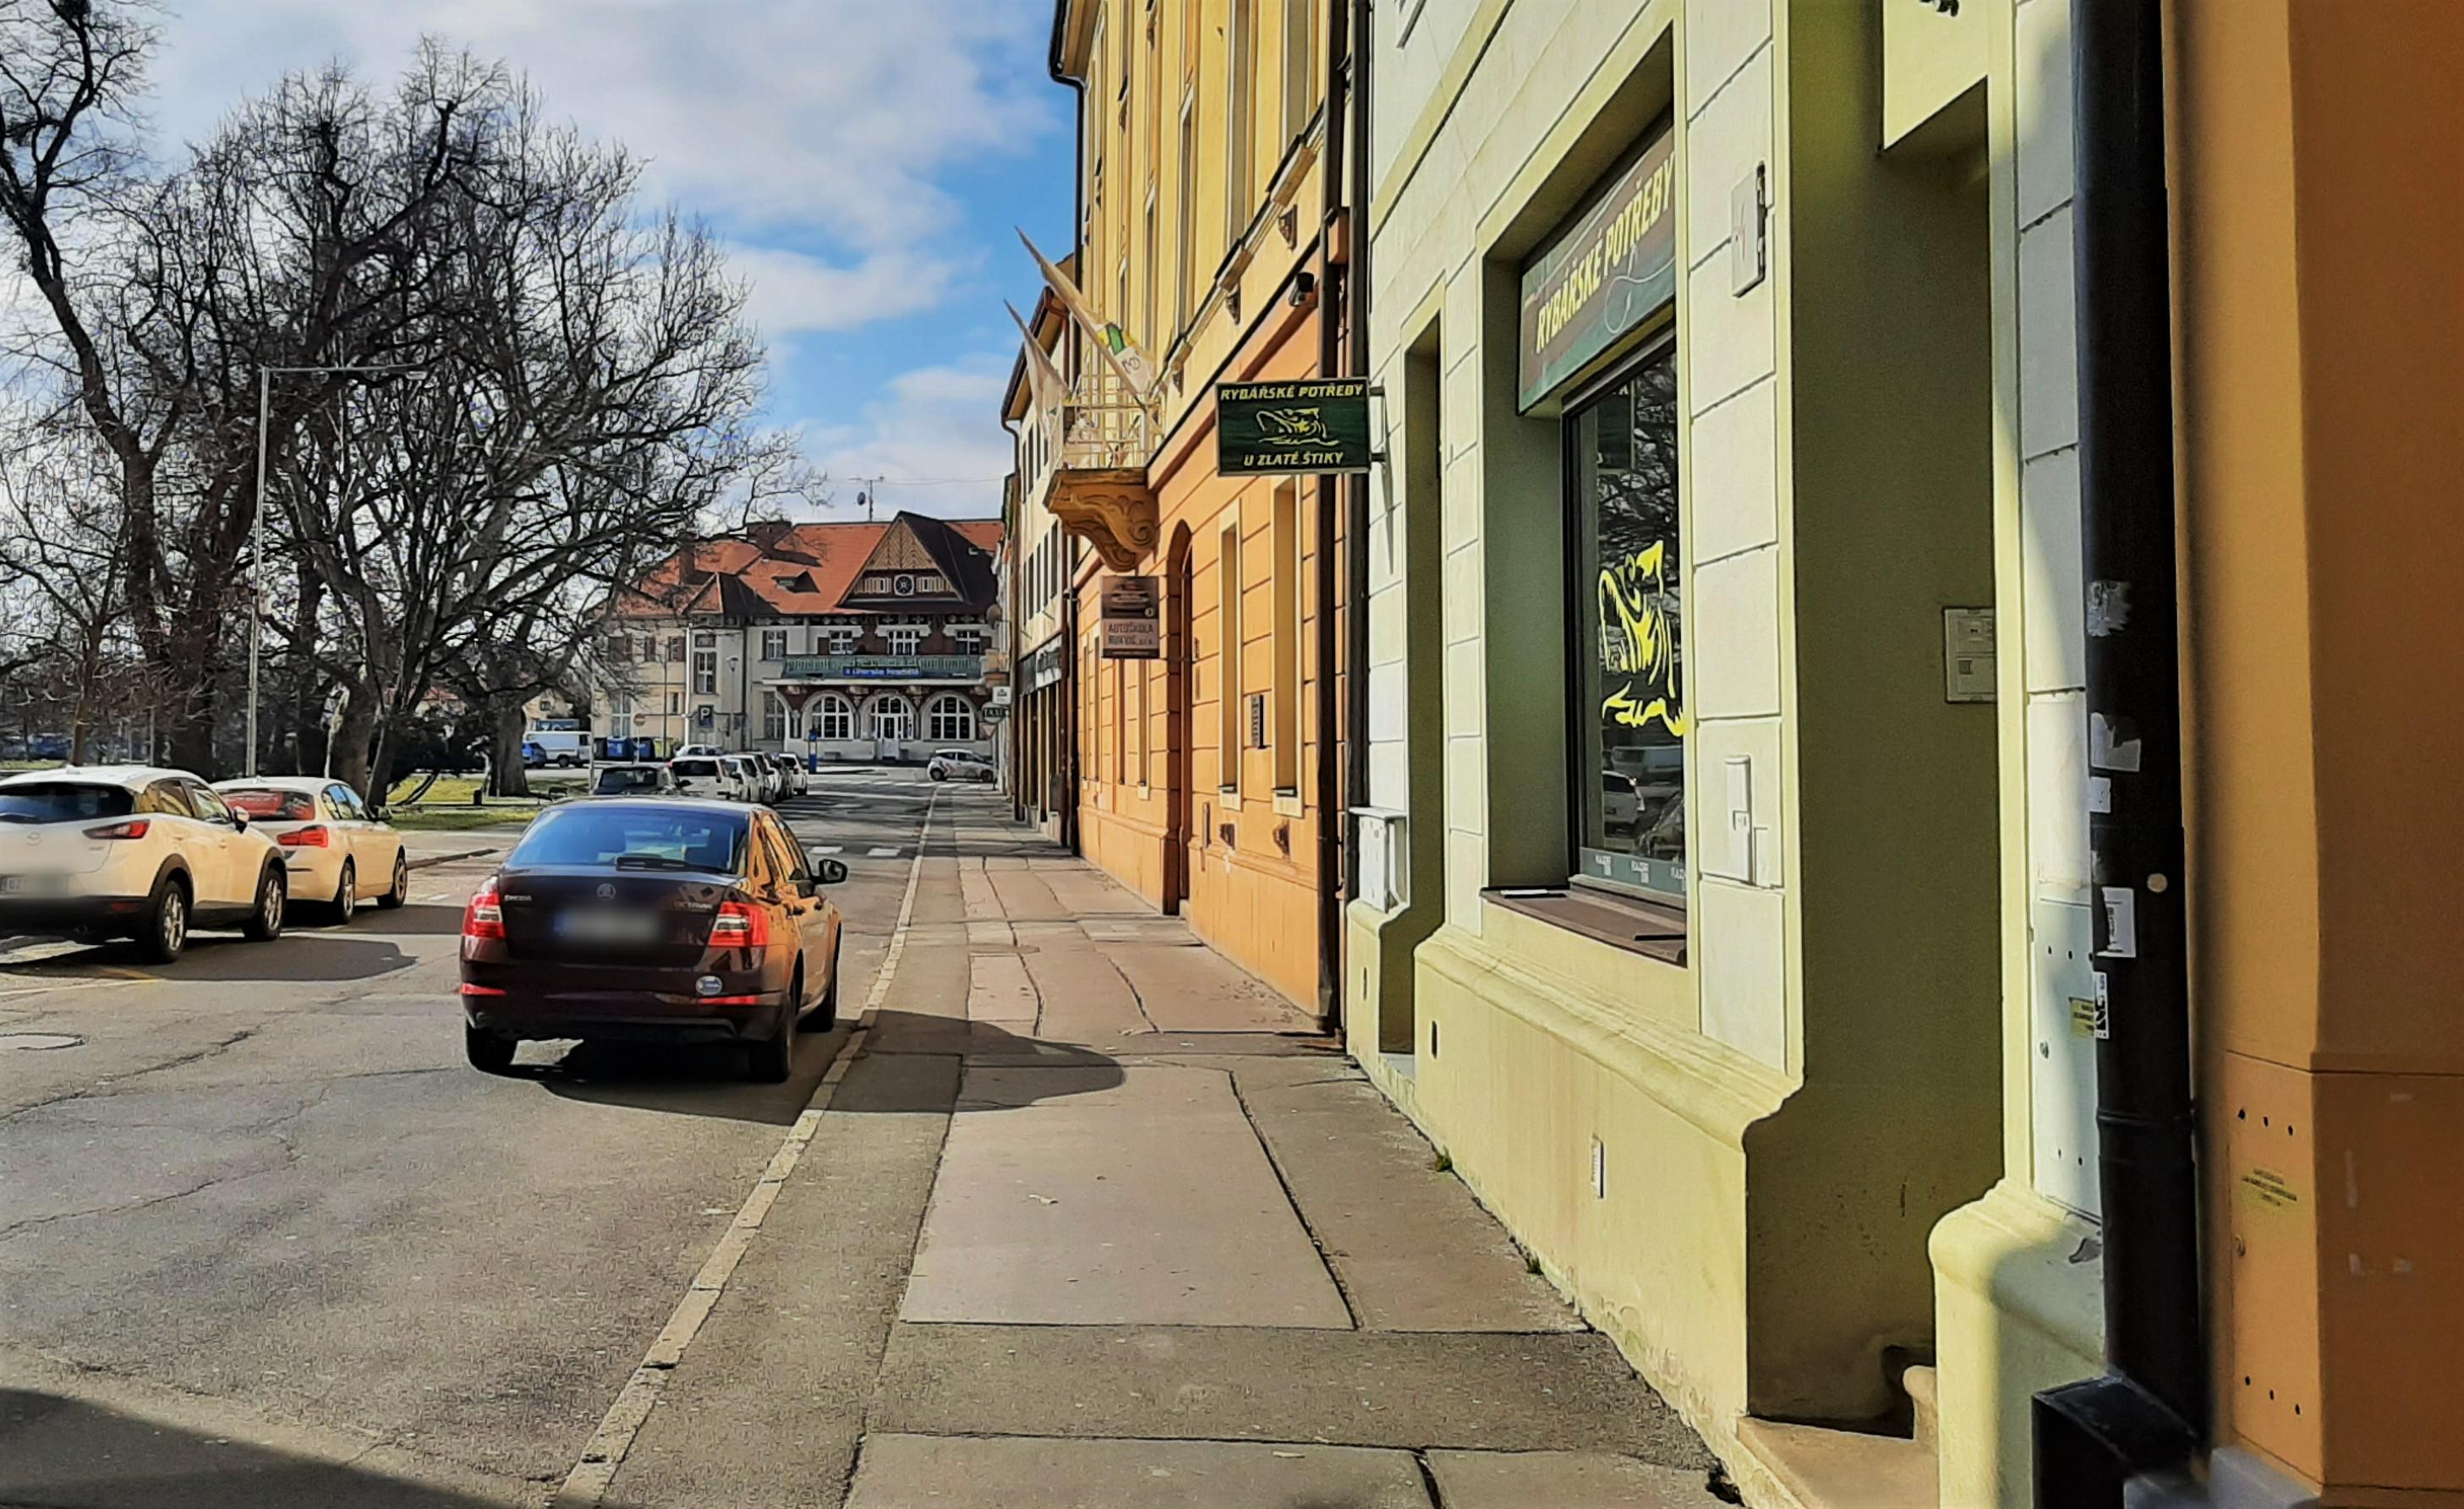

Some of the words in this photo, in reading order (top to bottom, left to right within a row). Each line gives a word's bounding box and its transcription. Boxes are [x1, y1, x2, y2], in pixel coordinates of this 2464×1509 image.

[1535, 227, 1604, 356] RYBÁŘSKÉ
[1603, 150, 1676, 279] POTŘEBY
[1220, 385, 1295, 401] RYBÁŘSKÉ
[1298, 382, 1365, 398] POTŘEBY
[1243, 455, 1254, 467] U
[1257, 452, 1299, 466] ZLATÉ
[1302, 451, 1344, 465] ŠTIKY
[701, 708, 711, 720] P
